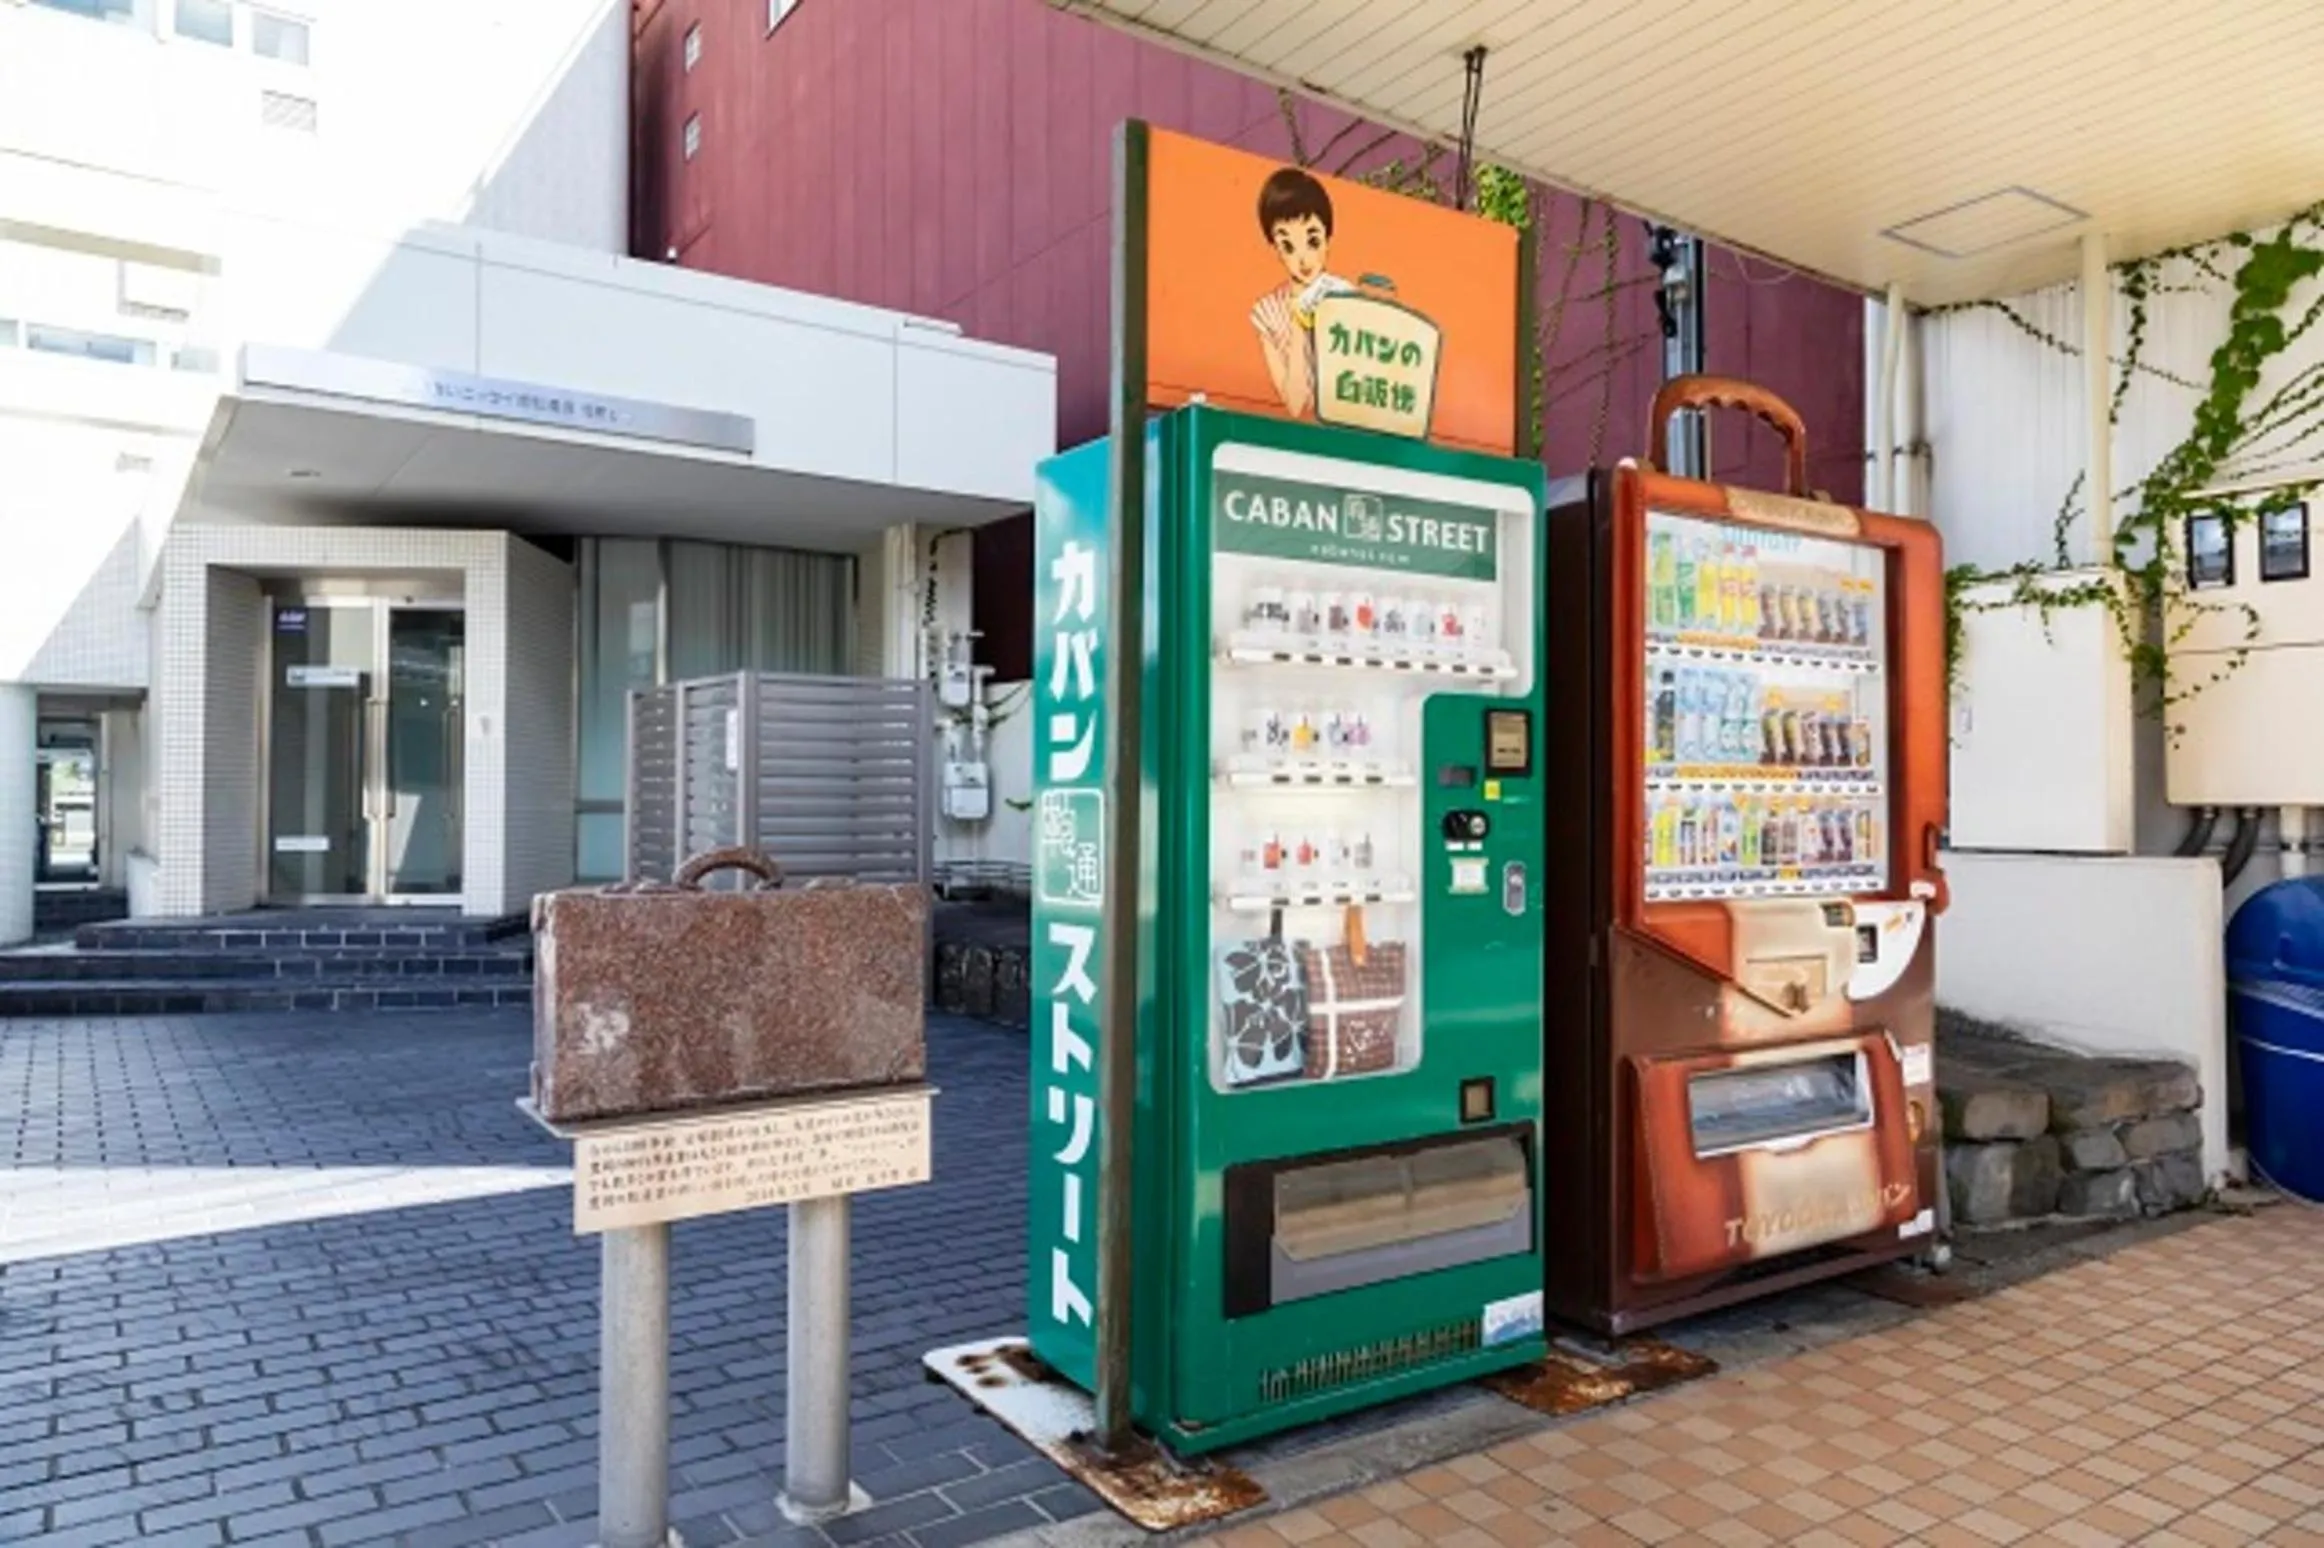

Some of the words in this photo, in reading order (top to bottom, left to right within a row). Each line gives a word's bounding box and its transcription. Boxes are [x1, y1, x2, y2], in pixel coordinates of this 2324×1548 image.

[1328, 321, 1422, 367] カバンの
[1224, 489, 1339, 534] CABAN
[1386, 511, 1490, 553] STREET
[1049, 540, 1099, 782] カバン
[1048, 921, 1098, 1329] ストリート
